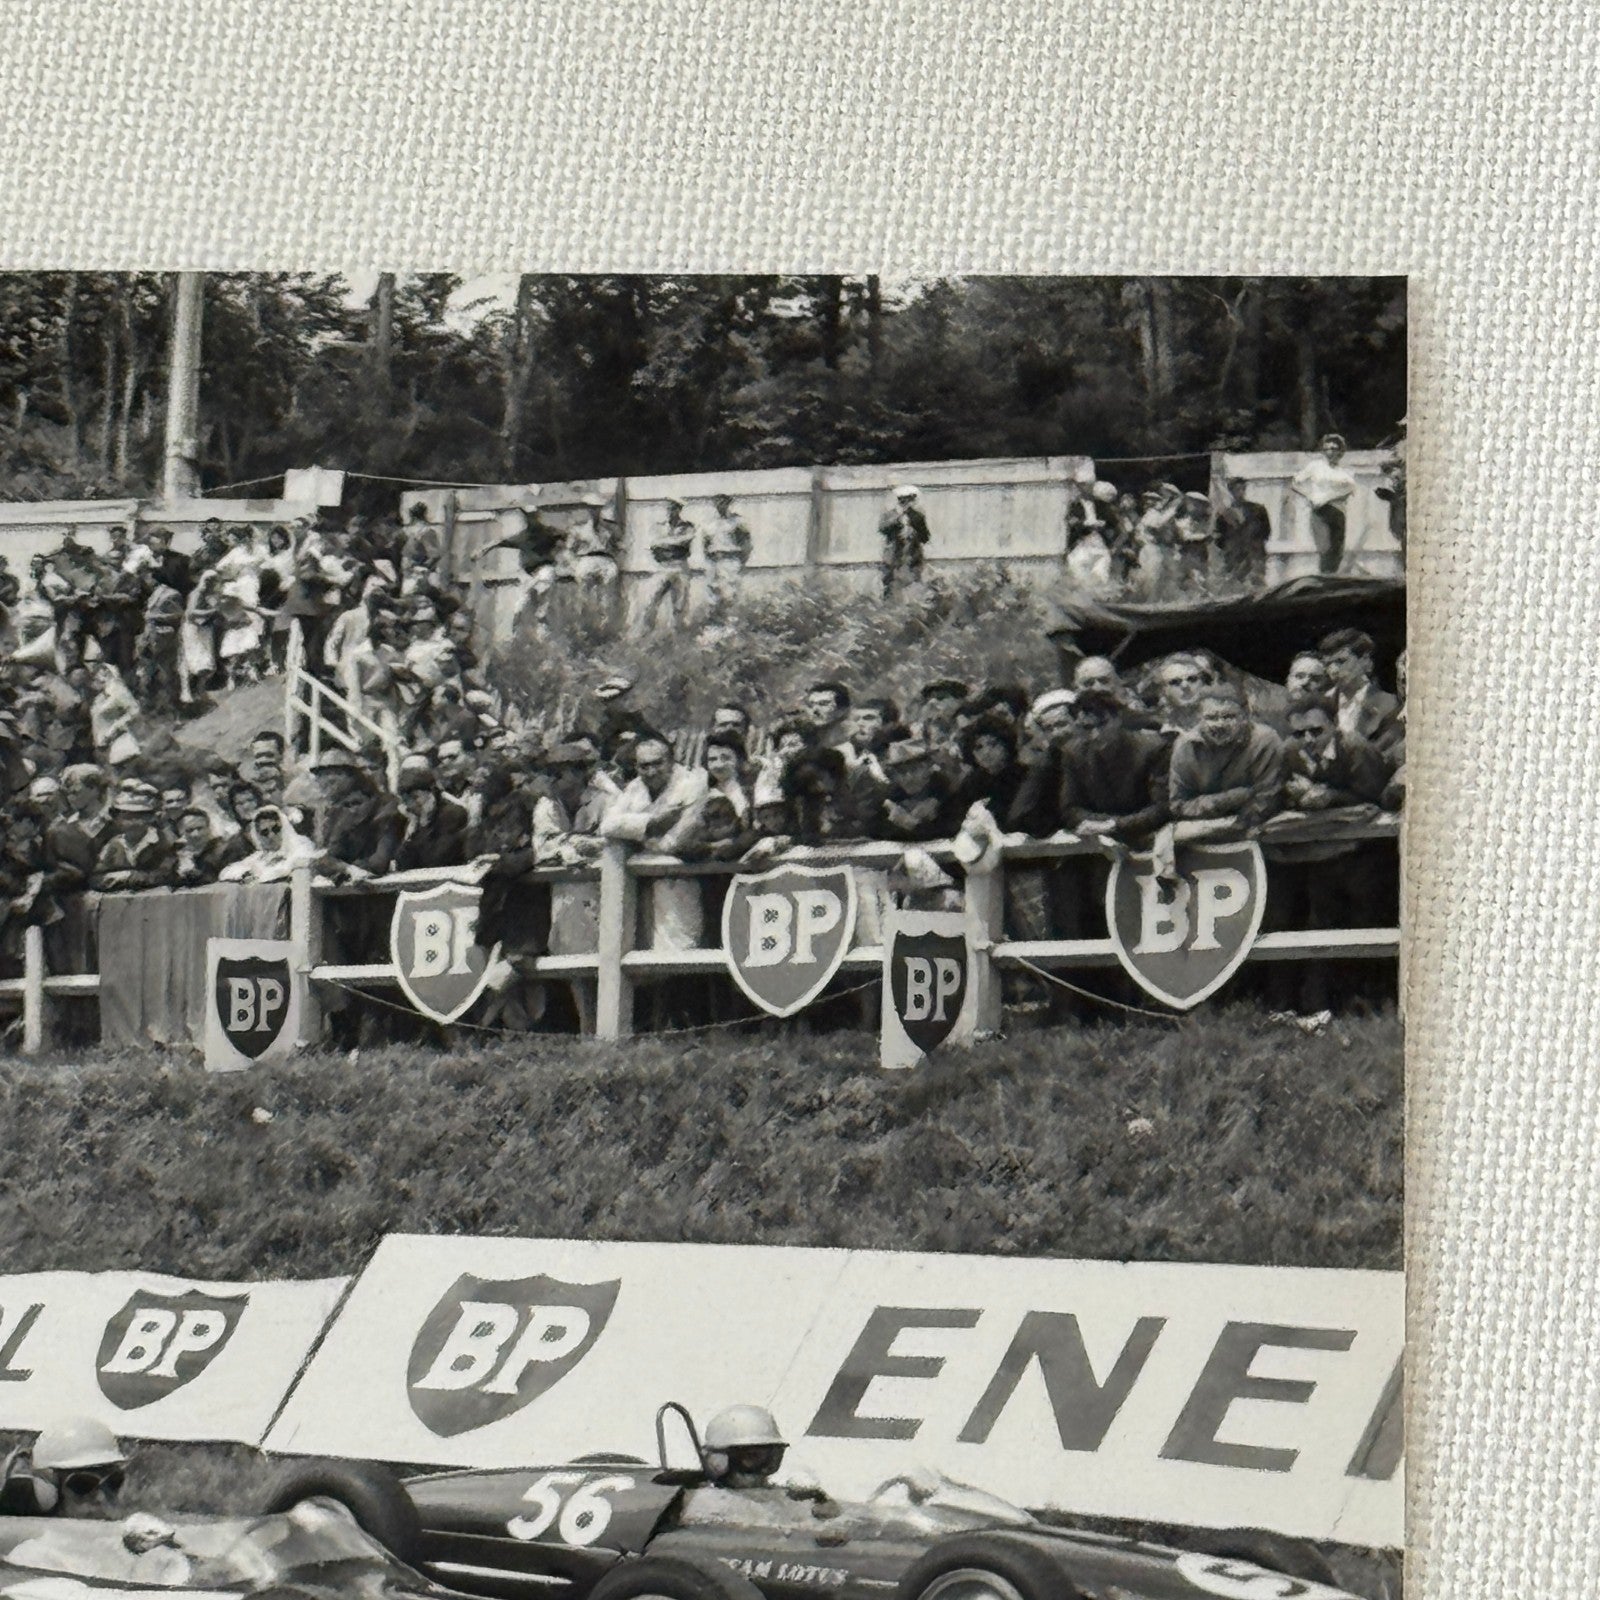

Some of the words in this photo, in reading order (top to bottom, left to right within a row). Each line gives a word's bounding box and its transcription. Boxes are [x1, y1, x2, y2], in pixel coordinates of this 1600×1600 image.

[741, 889, 842, 967] BP
[1132, 867, 1250, 954] BP
[225, 977, 284, 1031] BP
[903, 956, 961, 1021] BP
[0, 1302, 46, 1381] L
[100, 1308, 227, 1377] BP
[412, 1301, 591, 1394] BP
[507, 1471, 635, 1546] 56
